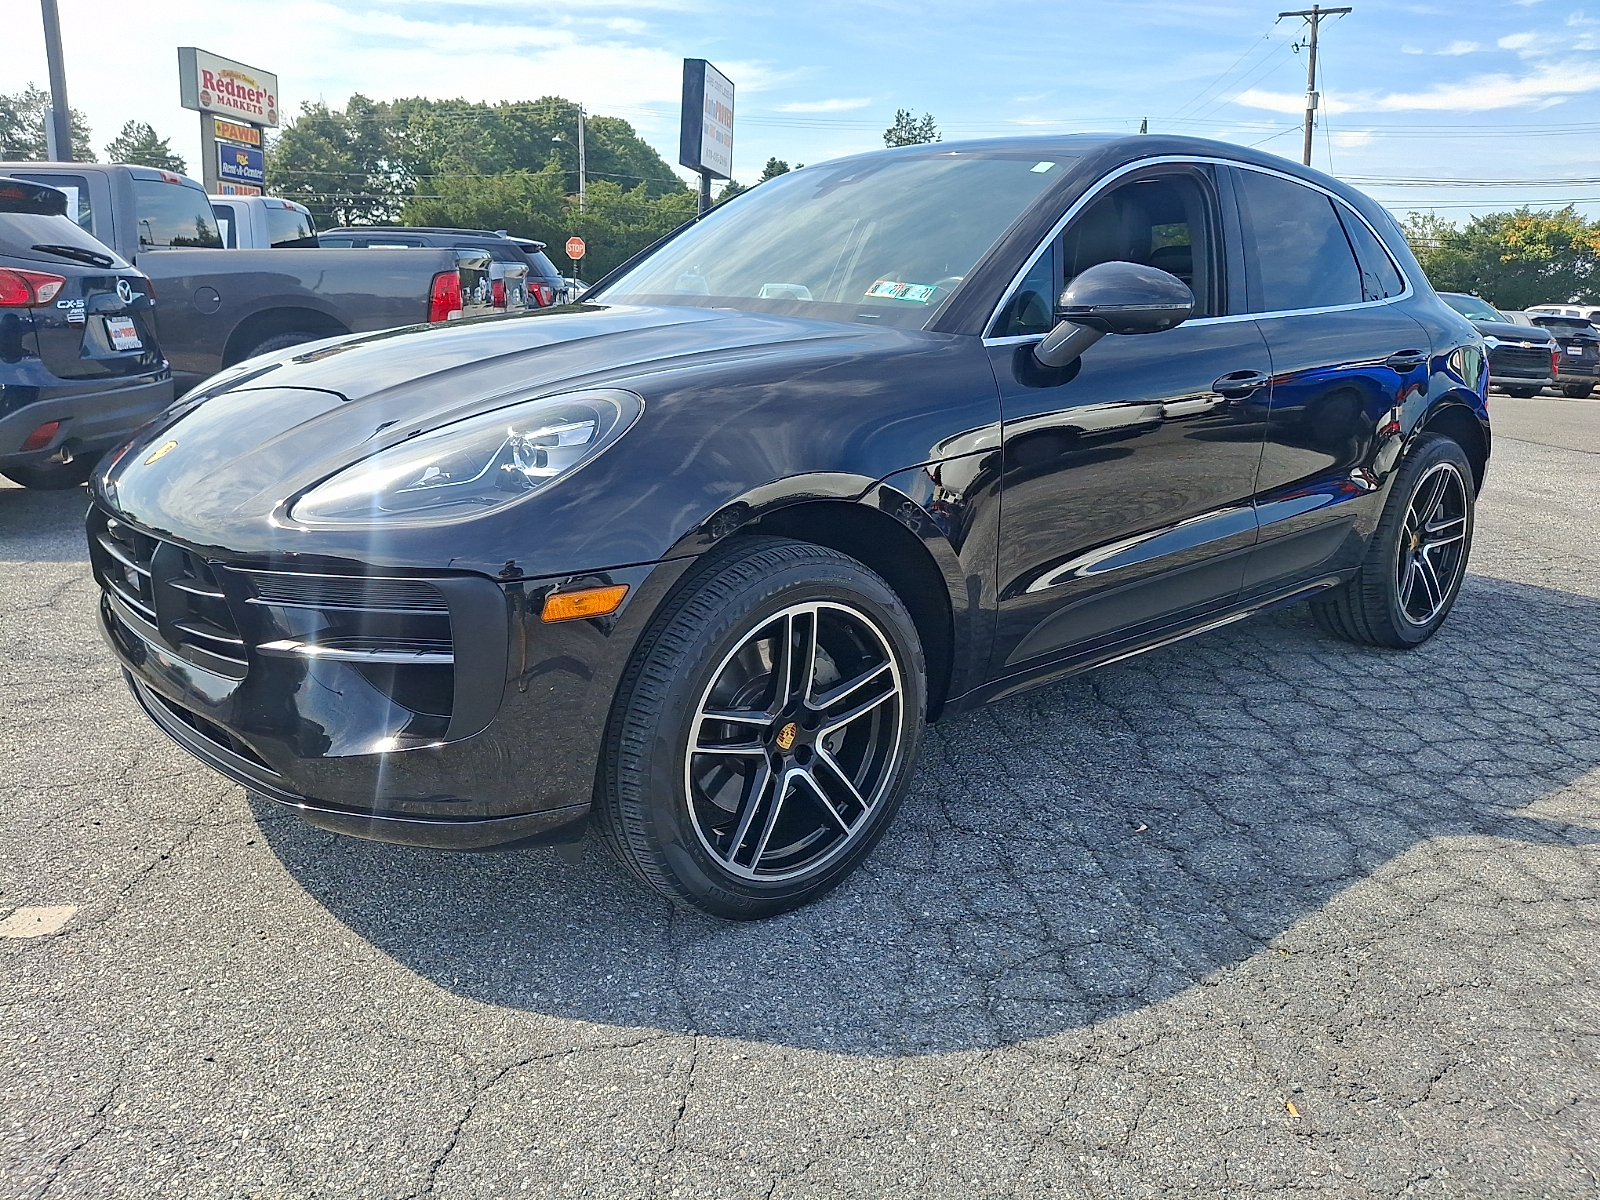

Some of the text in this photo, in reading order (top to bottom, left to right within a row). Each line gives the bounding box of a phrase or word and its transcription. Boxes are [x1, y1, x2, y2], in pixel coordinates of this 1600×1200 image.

[202, 69, 275, 108] Redner's
[217, 94, 263, 115] MARKETS
[222, 122, 259, 144] PAWN
[223, 162, 263, 178] Rent-A-Center
[568, 243, 584, 253] STOP
[57, 299, 85, 309] CX-5
